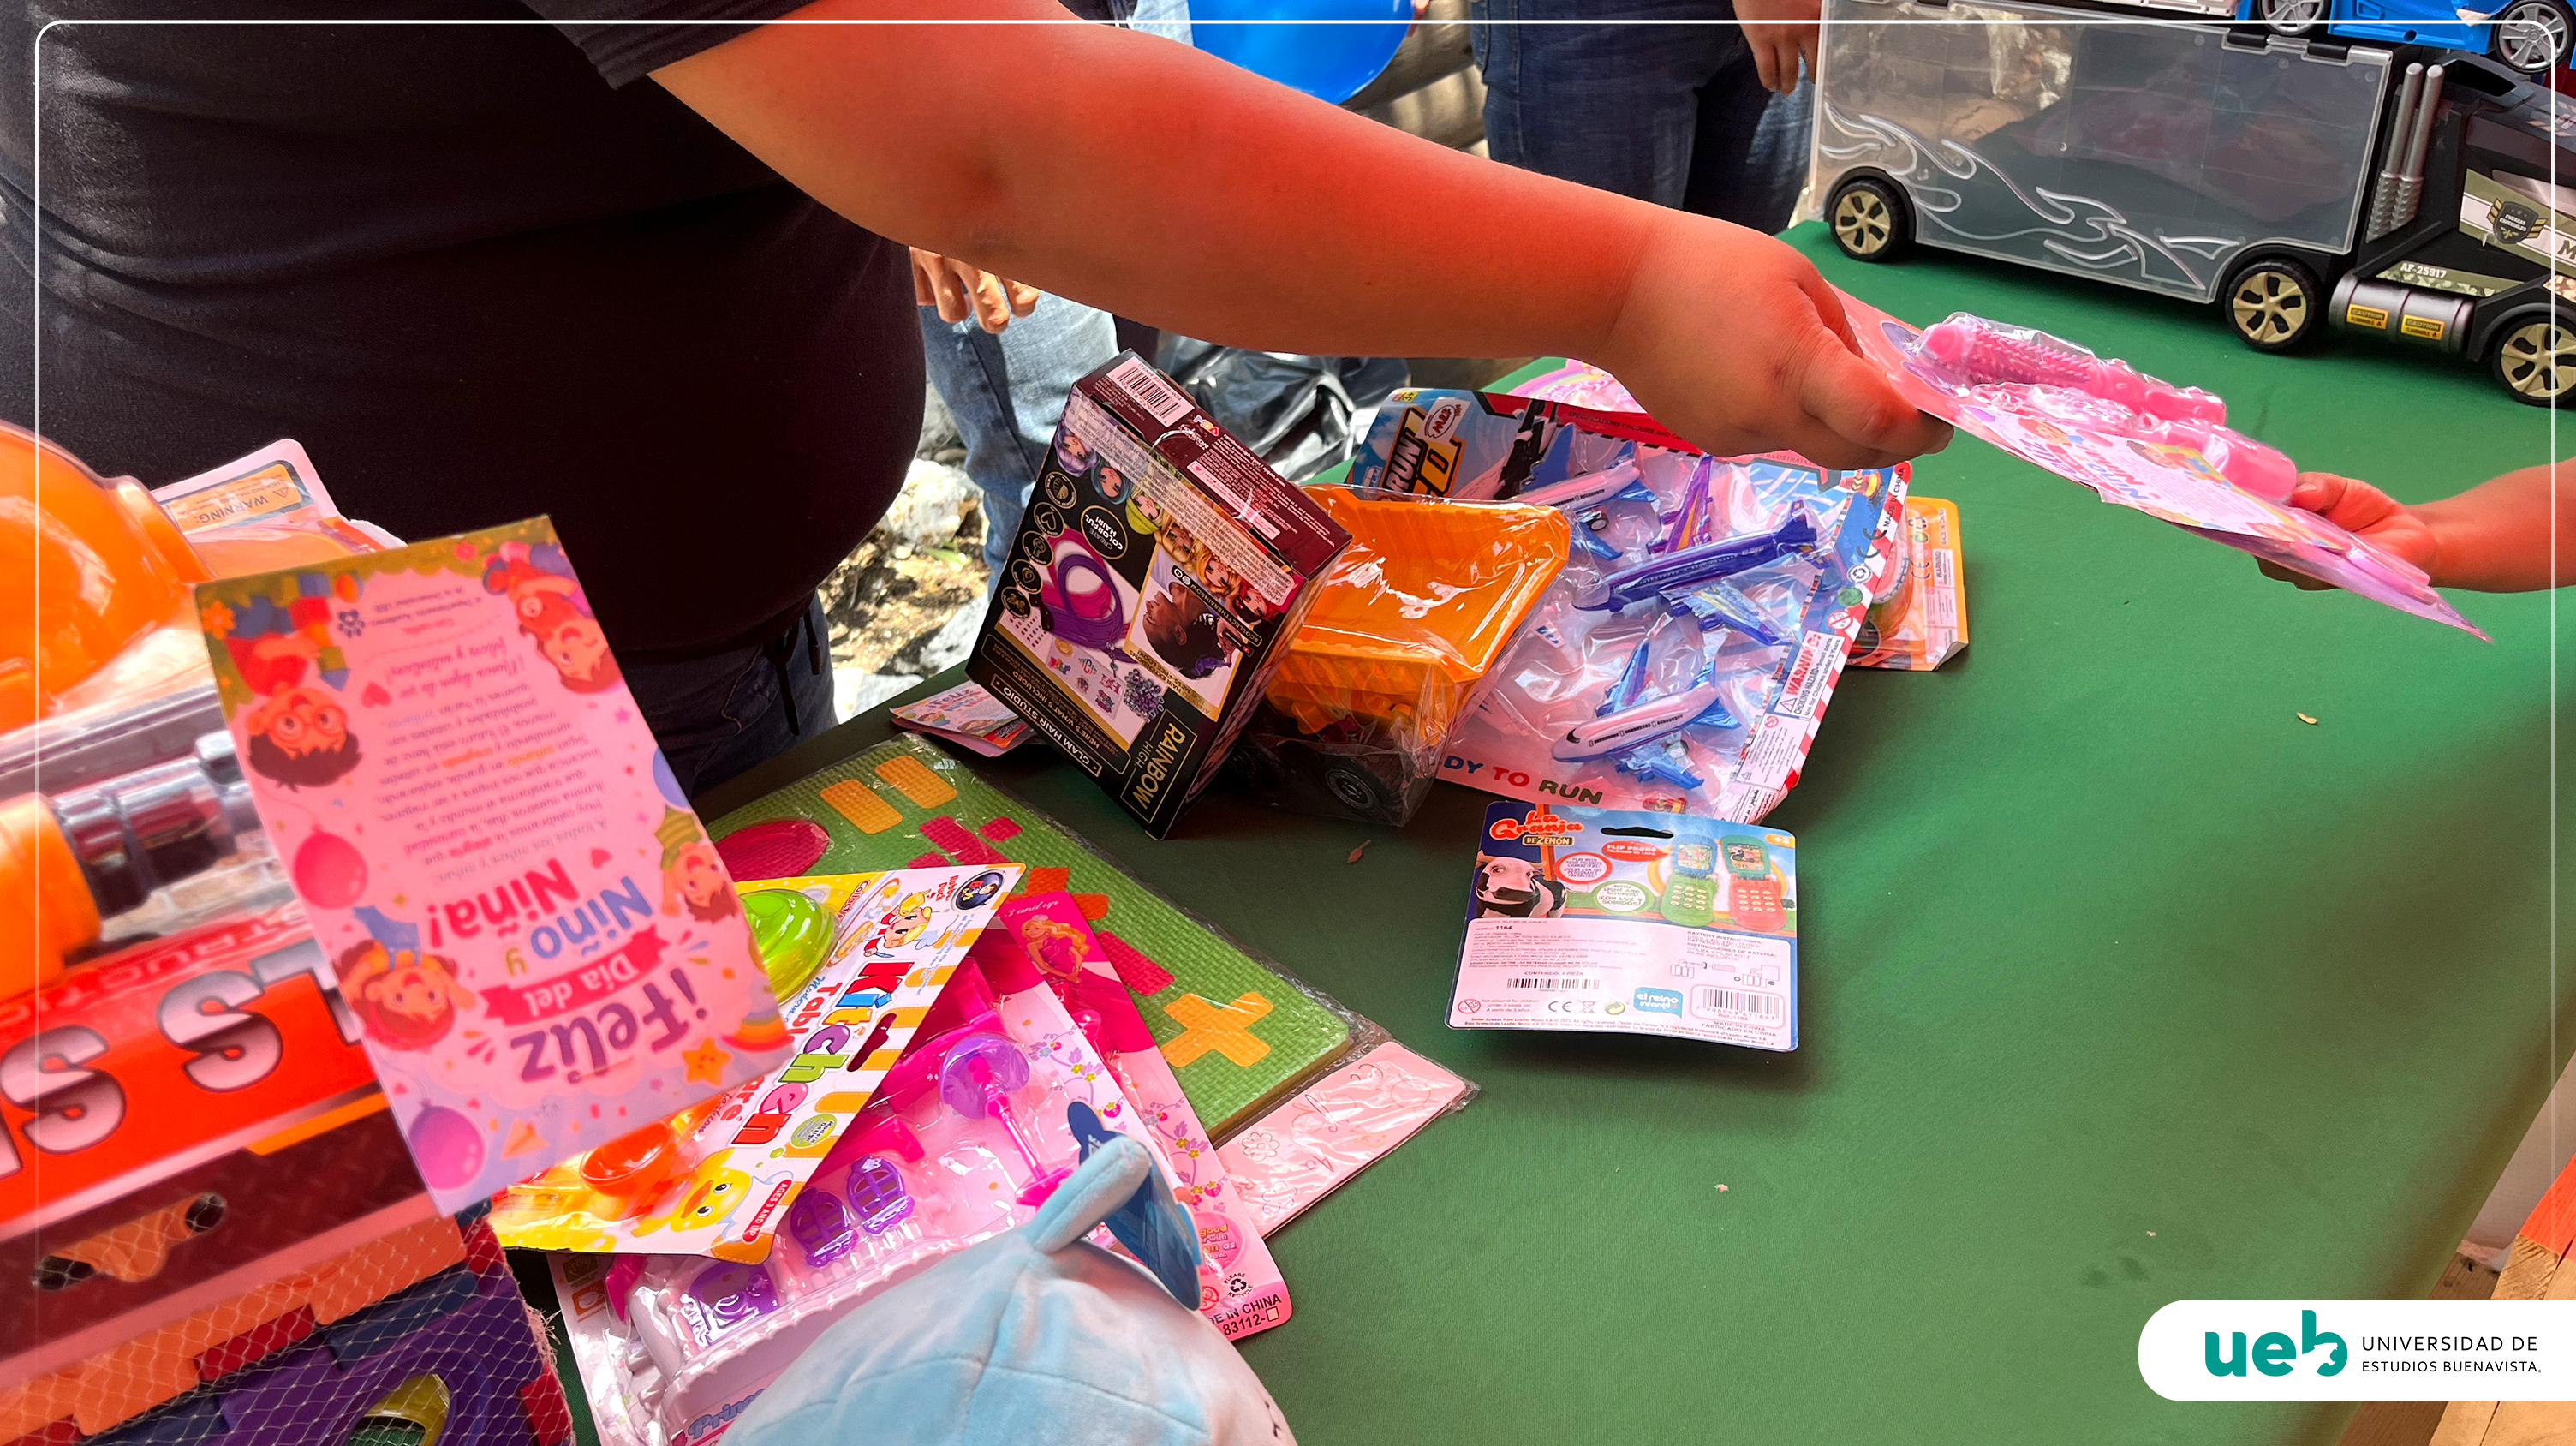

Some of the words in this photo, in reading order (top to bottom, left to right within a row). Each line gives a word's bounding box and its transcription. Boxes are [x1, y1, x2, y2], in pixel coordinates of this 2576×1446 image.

[2400, 261, 2448, 279] AF-25917
[2352, 308, 2384, 320] CAUTION
[2406, 319, 2440, 330] CAUTION
[1566, 410, 1620, 428] SPECIFICATIONS
[1620, 421, 1655, 435] COLOURS
[1655, 429, 1671, 439] AND
[1384, 436, 1422, 493] RUN
[1890, 465, 1908, 493] CHINA
[192, 493, 270, 525] WARNING:
[1890, 493, 1899, 503] IN
[1093, 515, 1118, 537] HAIR!
[1881, 504, 1897, 528] MADE
[1081, 512, 1124, 551] COLORFUL
[1087, 526, 1114, 551] CREATE
[1933, 550, 1944, 578] WARNING:
[1189, 581, 1260, 645] #COLLECTTHERAINBOW
[1829, 636, 1842, 654] Years.
[1127, 645, 1167, 684] EXTENSIONS
[1136, 648, 1157, 668] LOOK!
[1784, 630, 1822, 698] WARNING:
[1821, 657, 1833, 674] under
[1011, 669, 1048, 704] INCLUDED
[1157, 662, 1192, 696] MESS-FREE
[1165, 678, 1182, 694] HAIR
[1810, 673, 1826, 697] Children
[1001, 684, 1040, 720] STUDIO
[1046, 701, 1075, 726] WHAT'S
[1792, 688, 1810, 715] CHOKING
[1803, 705, 1813, 717] Not
[1807, 696, 1816, 706] for
[1037, 716, 1063, 741] HAIR
[1072, 723, 1100, 750] HERE'S
[1060, 737, 1091, 765] GLAM
[1133, 739, 1154, 768] HIGH
[1128, 721, 1189, 810] RAINBOW
[1492, 764, 1531, 789] TO
[1538, 779, 1603, 805] RUN
[1489, 817, 1583, 840] Granja
[1527, 810, 1559, 825] La
[1526, 836, 1536, 845] DE
[1536, 835, 1571, 845] ZENÓN
[426, 857, 579, 941] Niña!
[935, 881, 947, 901] Duck
[530, 875, 654, 960] Niño
[1016, 905, 1040, 915] and
[1041, 900, 1058, 910] up
[1686, 942, 1736, 953] INSTRUCCIONES
[507, 946, 529, 978] y
[568, 957, 638, 998] Día
[524, 979, 574, 1016] del
[787, 970, 825, 1019] Modern
[1639, 1000, 1671, 1010] infantil
[1648, 992, 1679, 1003] reino
[510, 969, 709, 1085] ¡Feliz
[1701, 1023, 1742, 1032] FABRICADO
[731, 961, 913, 1149] Kitchen
[805, 1119, 827, 1145] Design
[809, 1118, 834, 1148] Modern
[769, 1180, 788, 1204] AGES
[754, 1207, 770, 1225] AND
[745, 1222, 759, 1237] UP
[1198, 1221, 1229, 1240] good
[1208, 1230, 1229, 1244] with
[1221, 1238, 1237, 1252] as
[1221, 1270, 1247, 1284] PLEASE
[1225, 1282, 1256, 1301] RECYCLE
[1225, 1306, 1239, 1320] IN
[1240, 1292, 1282, 1315] CHINA
[1220, 1311, 1267, 1336] 83112-
[689, 1388, 766, 1440] Prin
